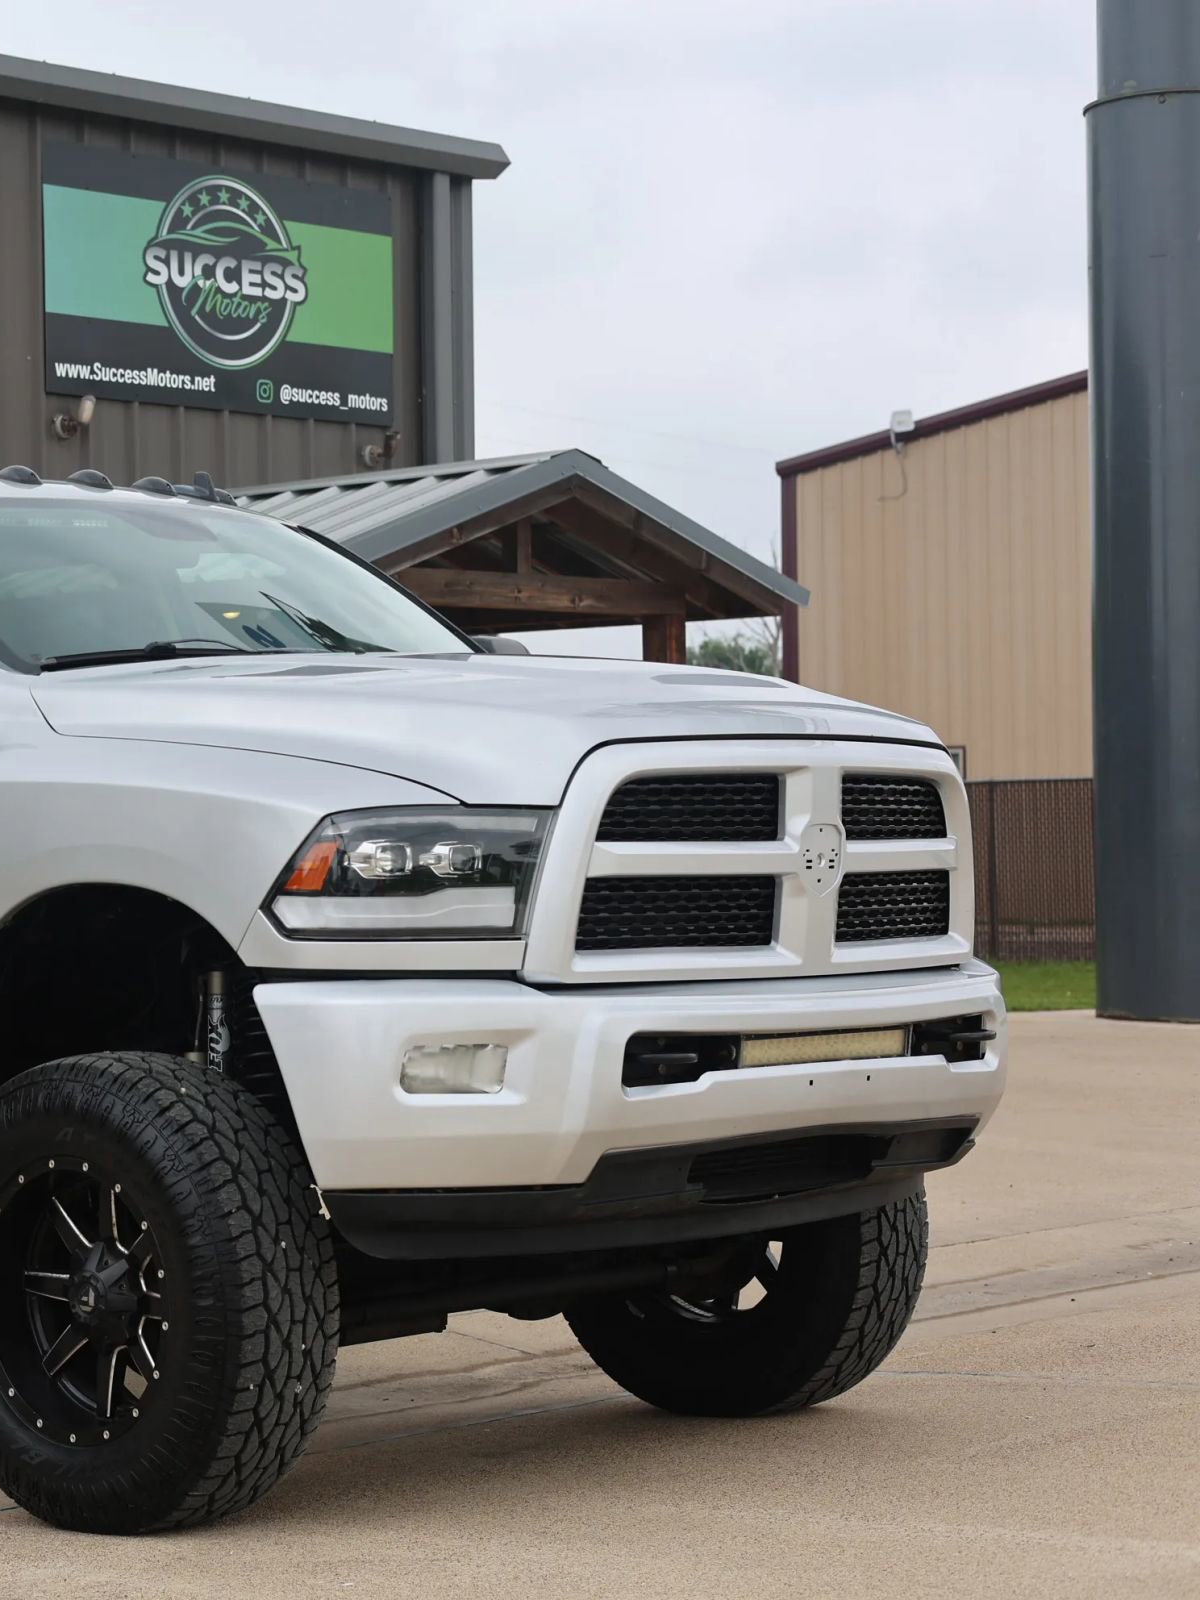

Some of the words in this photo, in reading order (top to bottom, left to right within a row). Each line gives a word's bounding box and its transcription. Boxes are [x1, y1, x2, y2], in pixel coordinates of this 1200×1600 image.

[145, 247, 307, 302] SUCCESS
[182, 274, 272, 323] Motors
[55, 361, 216, 392] www.SuccessMotors.net
[280, 384, 388, 412] @success_motors
[207, 1014, 225, 1073] FOX
